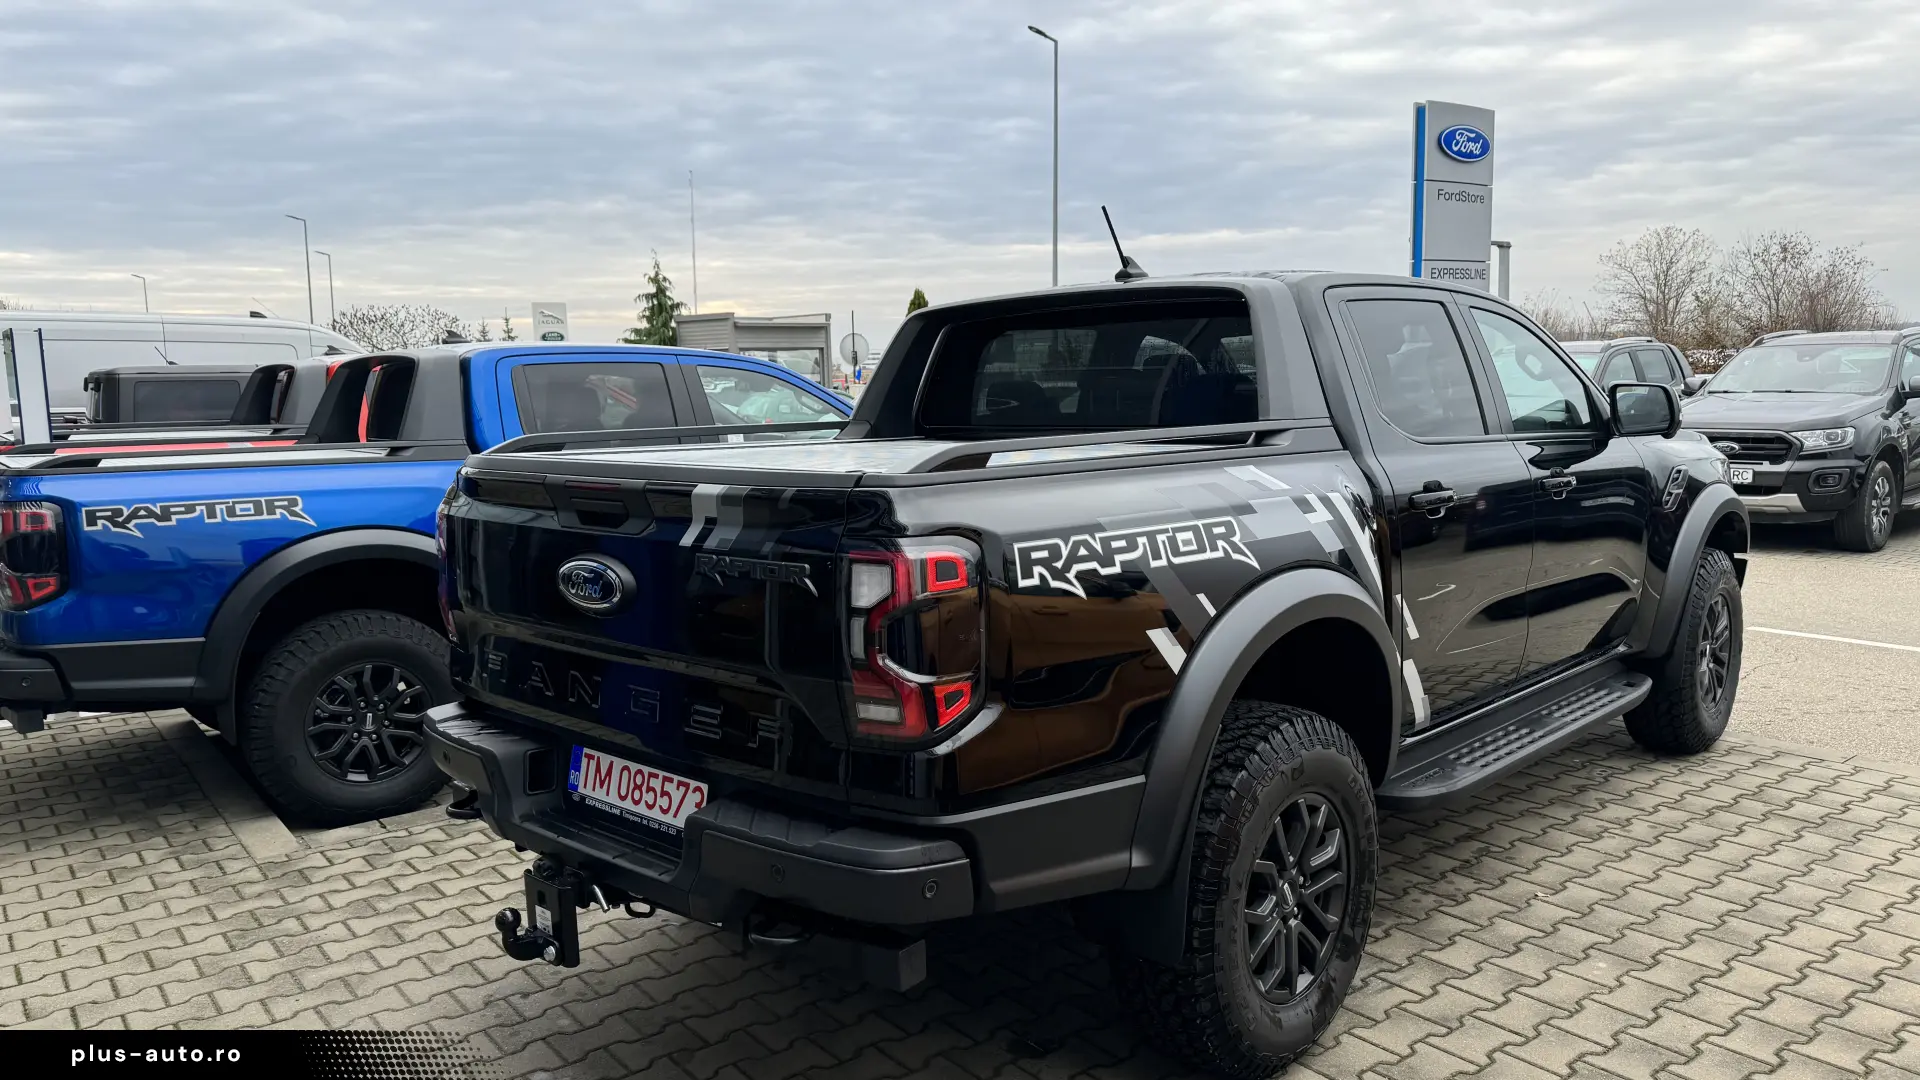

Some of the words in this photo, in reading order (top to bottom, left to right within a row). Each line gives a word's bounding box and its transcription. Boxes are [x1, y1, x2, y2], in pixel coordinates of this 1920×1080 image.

[1452, 129, 1482, 155] Ford
[1437, 188, 1485, 204] FordStore
[1430, 267, 1487, 281] EXPRESSLINE
[82, 495, 317, 538] RAPTOR
[1013, 516, 1261, 600] RAPTOR
[569, 570, 602, 598] Ford
[695, 553, 819, 598] RAPTOR
[570, 769, 580, 785] RO
[583, 752, 614, 797] TM
